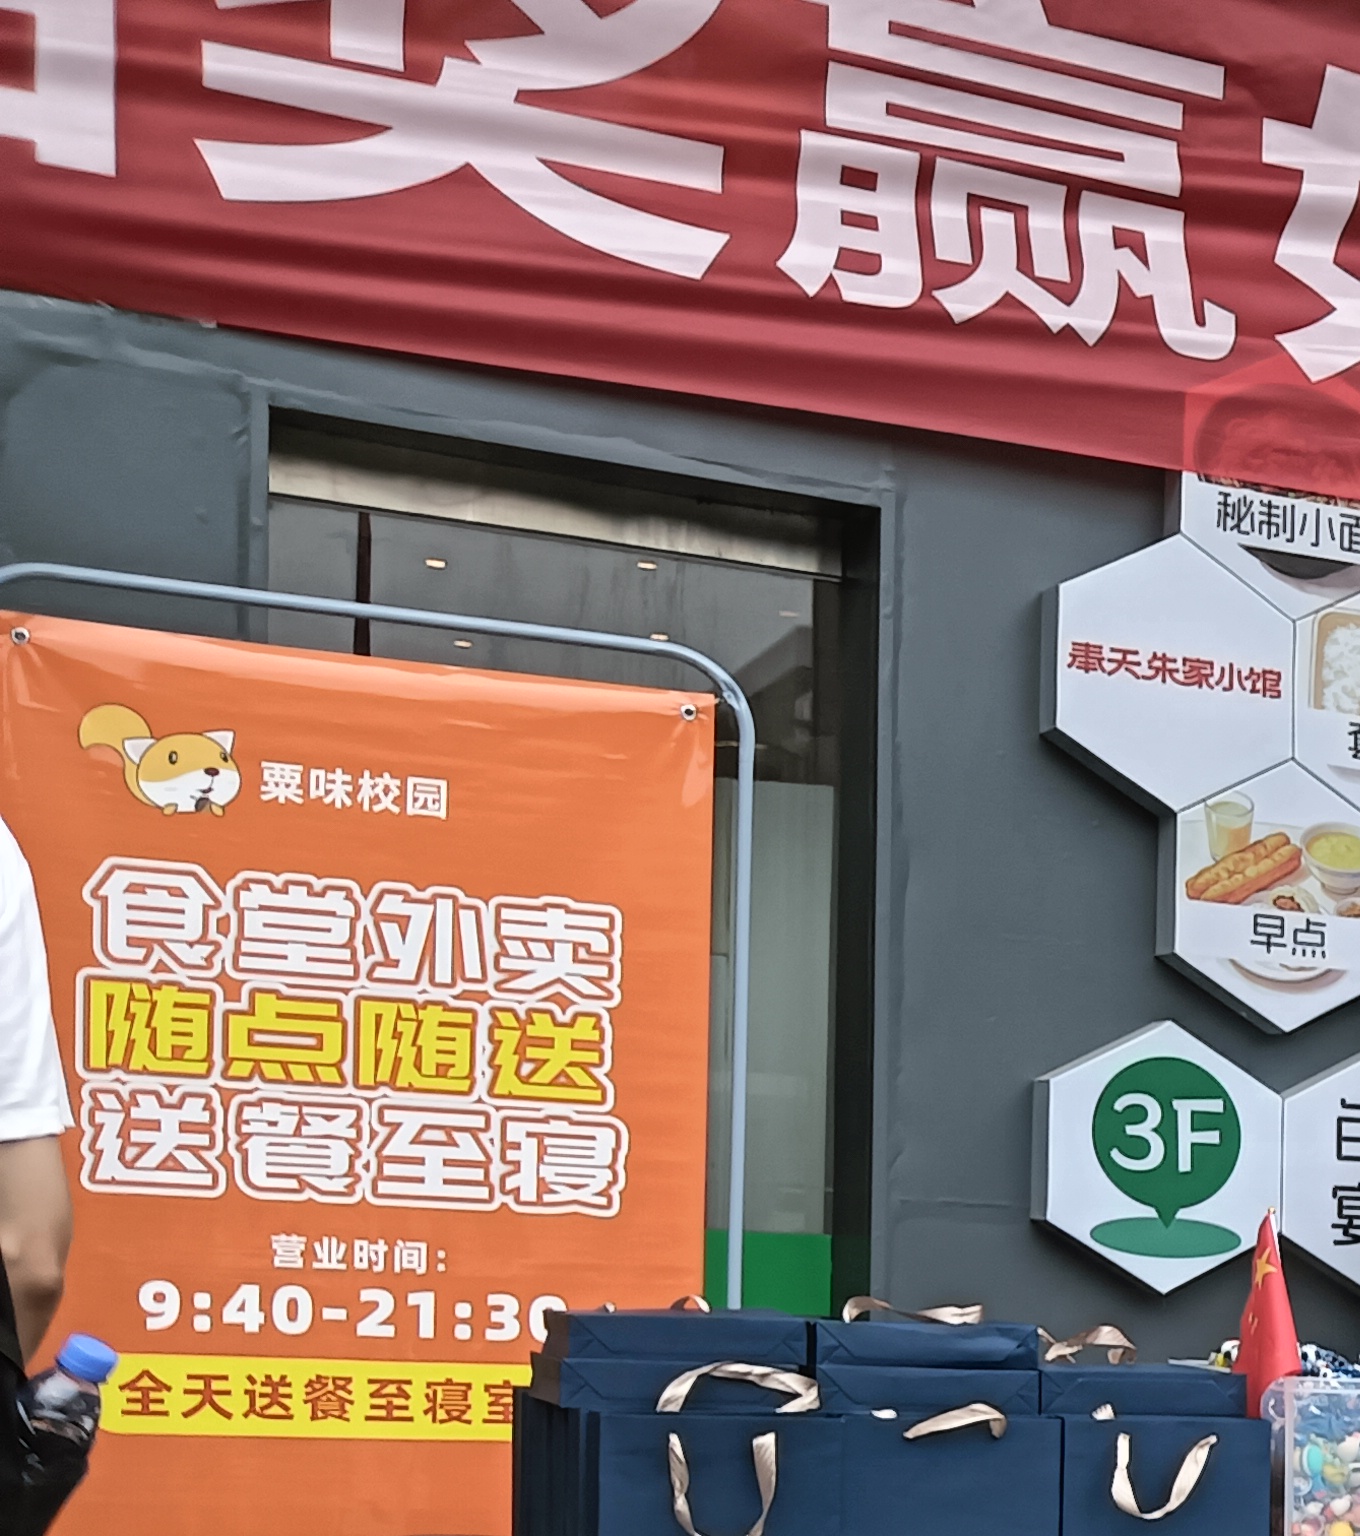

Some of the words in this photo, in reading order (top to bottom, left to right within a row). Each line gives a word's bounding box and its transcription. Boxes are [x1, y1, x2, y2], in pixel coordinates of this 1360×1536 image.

[1067, 641, 1283, 699] 奉天朱家小馆
[83, 857, 624, 1008] 食堂外卖
[1250, 913, 1328, 959] 早点
[76, 968, 614, 1108] 随点随送
[81, 1087, 629, 1218] 送餐至寝
[1109, 1092, 1224, 1173] 3F
[271, 1234, 448, 1275] 营业时间：
[137, 1281, 566, 1342] 9:40-21:30
